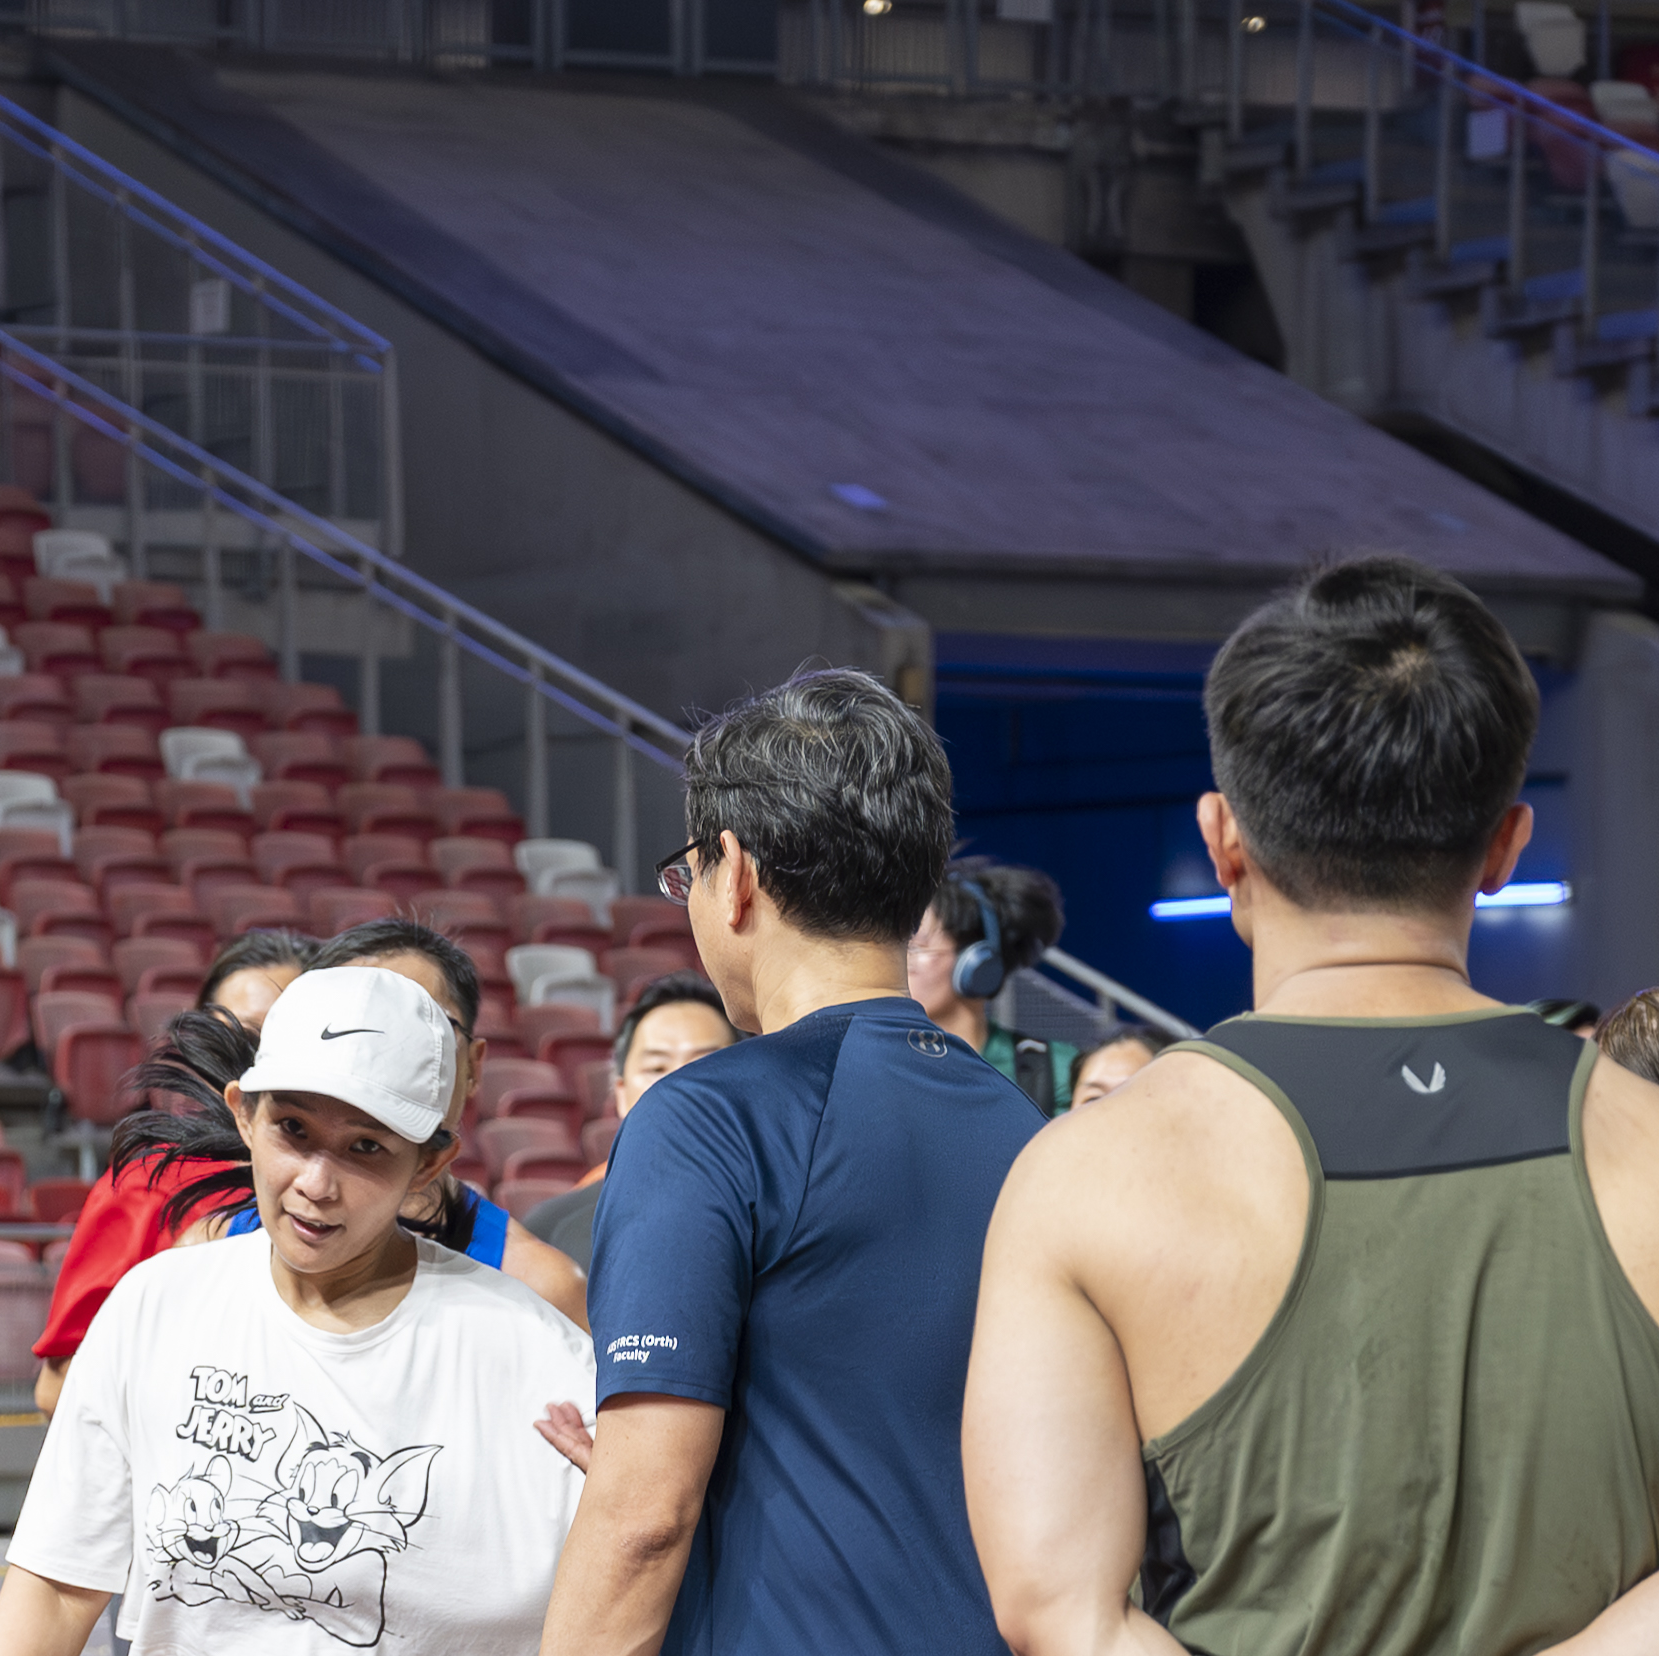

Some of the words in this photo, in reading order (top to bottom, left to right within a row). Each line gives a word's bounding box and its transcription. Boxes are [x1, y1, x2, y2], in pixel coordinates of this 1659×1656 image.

[612, 1348, 650, 1364] Faculty
[640, 1334, 678, 1351] (Orth)
[189, 1364, 248, 1408] TOM
[248, 1392, 291, 1414] and
[175, 1405, 277, 1462] JERRY
